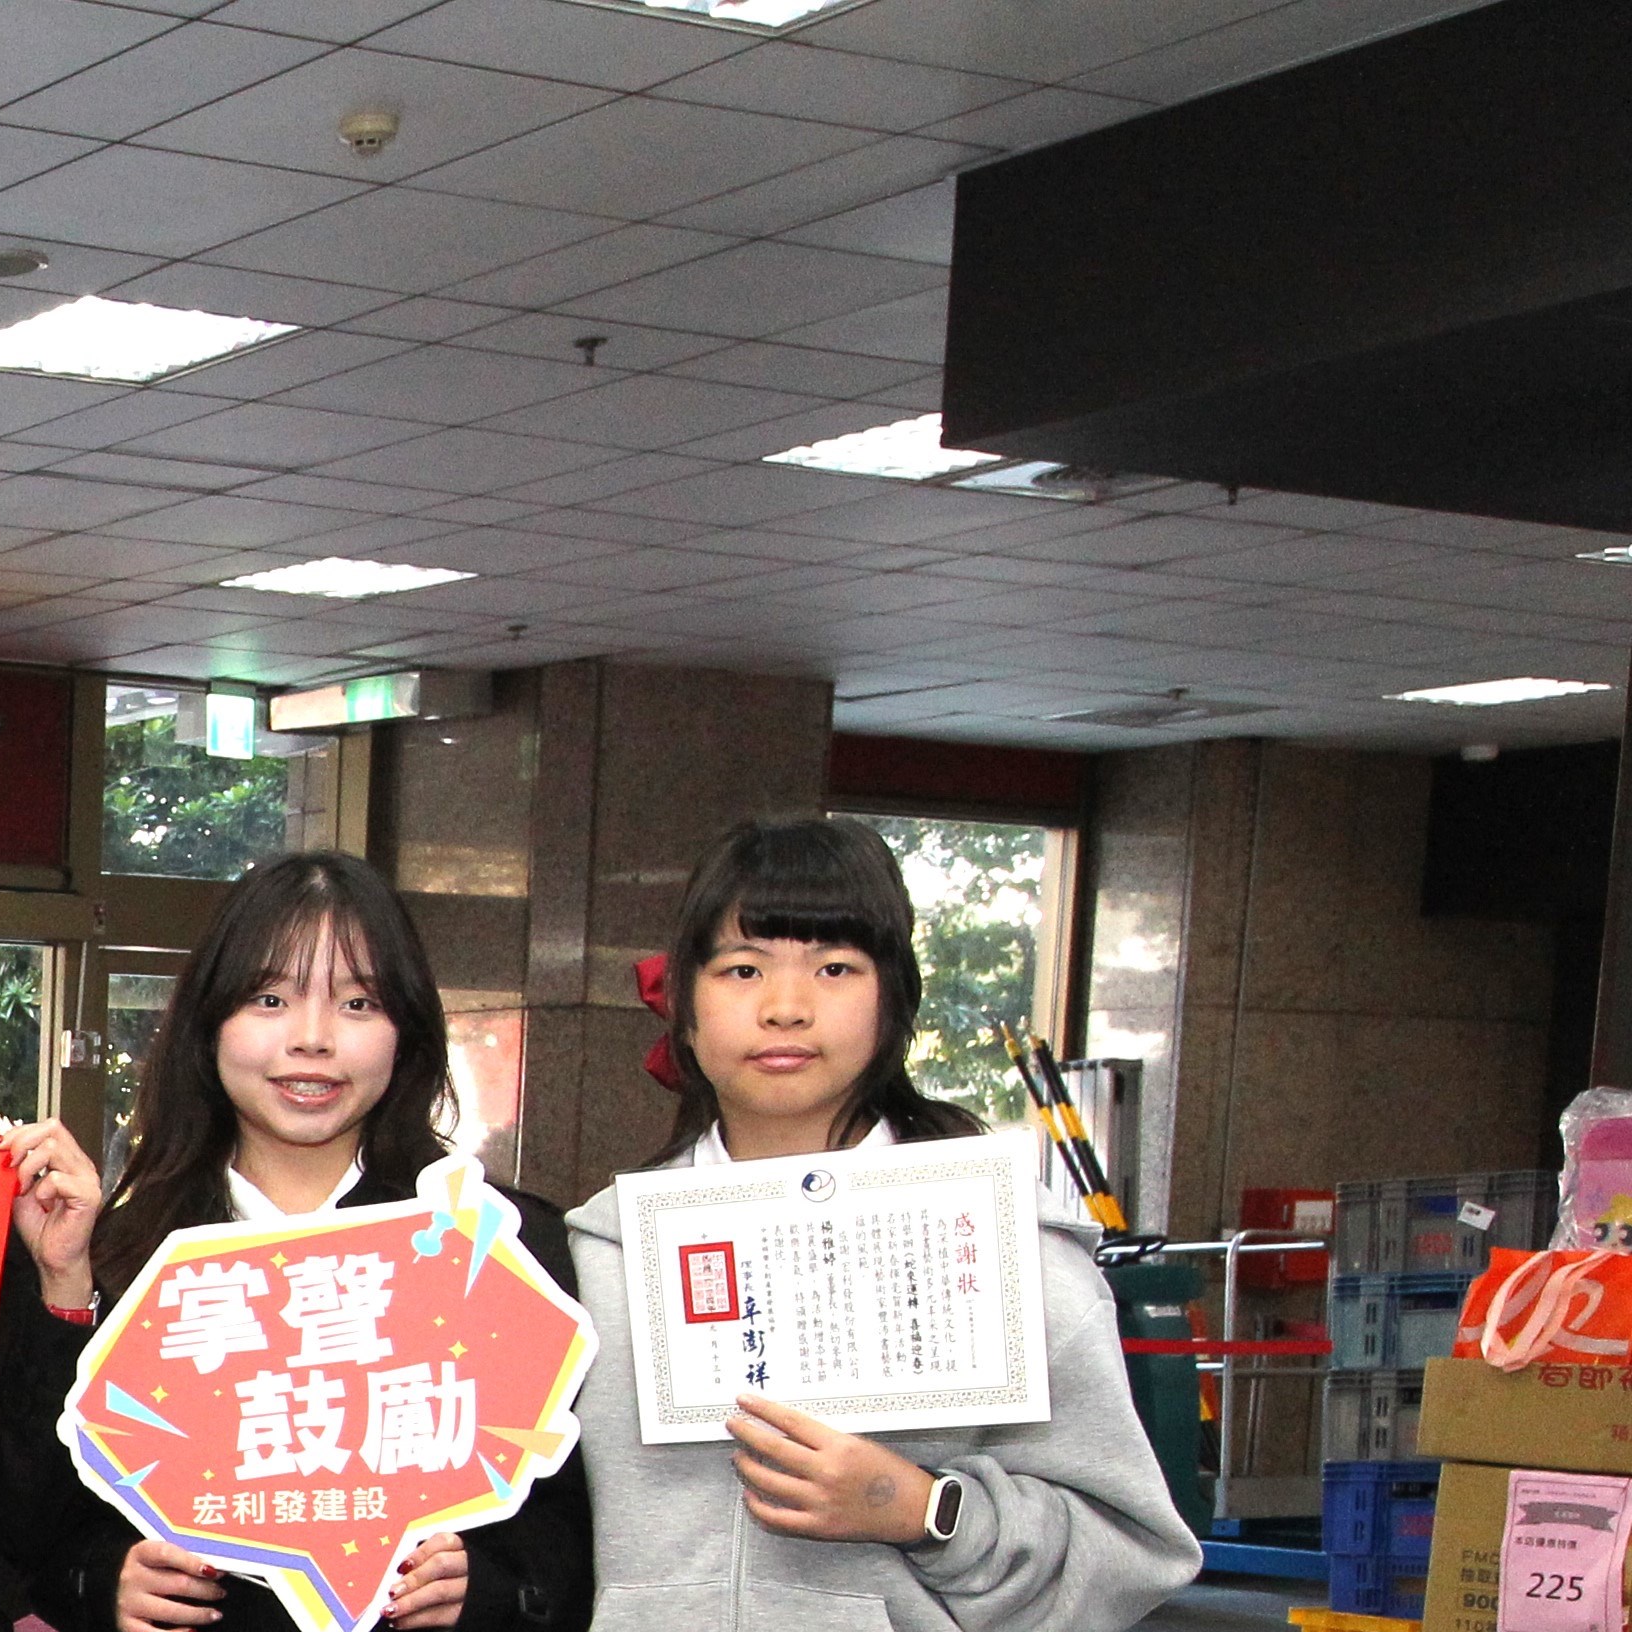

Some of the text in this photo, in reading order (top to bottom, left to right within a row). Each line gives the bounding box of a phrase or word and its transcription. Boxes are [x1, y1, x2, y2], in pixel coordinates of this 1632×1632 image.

[954, 1211, 980, 1295] 感謝狀
[158, 1252, 395, 1375] 掌聲
[234, 1361, 477, 1480] 鼓勵
[192, 1486, 389, 1526] 宏利發建設
[1525, 1572, 1584, 1601] 225
